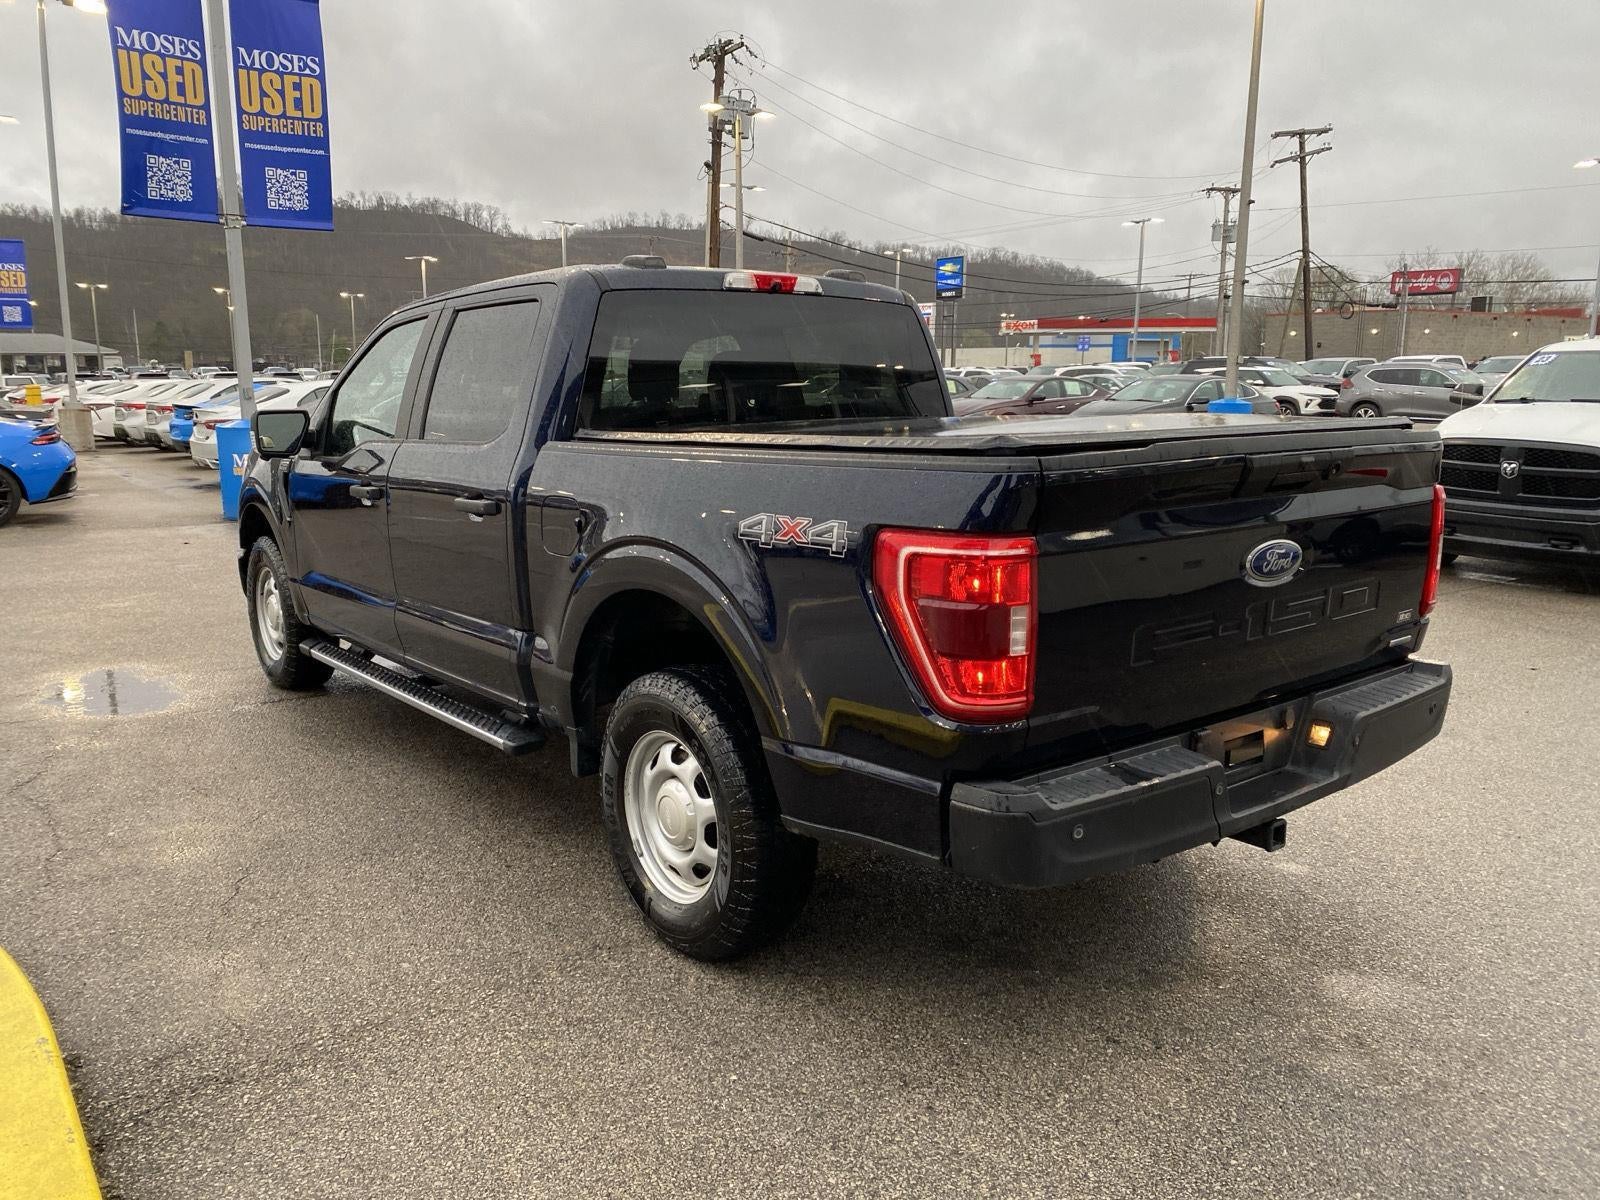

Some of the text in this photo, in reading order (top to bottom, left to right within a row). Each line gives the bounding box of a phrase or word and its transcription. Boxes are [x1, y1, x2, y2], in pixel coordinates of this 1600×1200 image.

[114, 26, 202, 60] MOSES
[237, 46, 321, 76] MOSES
[117, 48, 206, 107] USED
[238, 68, 323, 119] USED
[123, 97, 208, 126] SUPERCENTER
[242, 114, 325, 138] SUPERCENTER
[244, 142, 325, 156] mosesusedsupercenter.com
[0, 262, 25, 272] OSES
[0, 270, 27, 288] SED
[1004, 320, 1036, 333] EXXON
[1262, 548, 1294, 573] Ford
[1130, 577, 1381, 667] F-150
